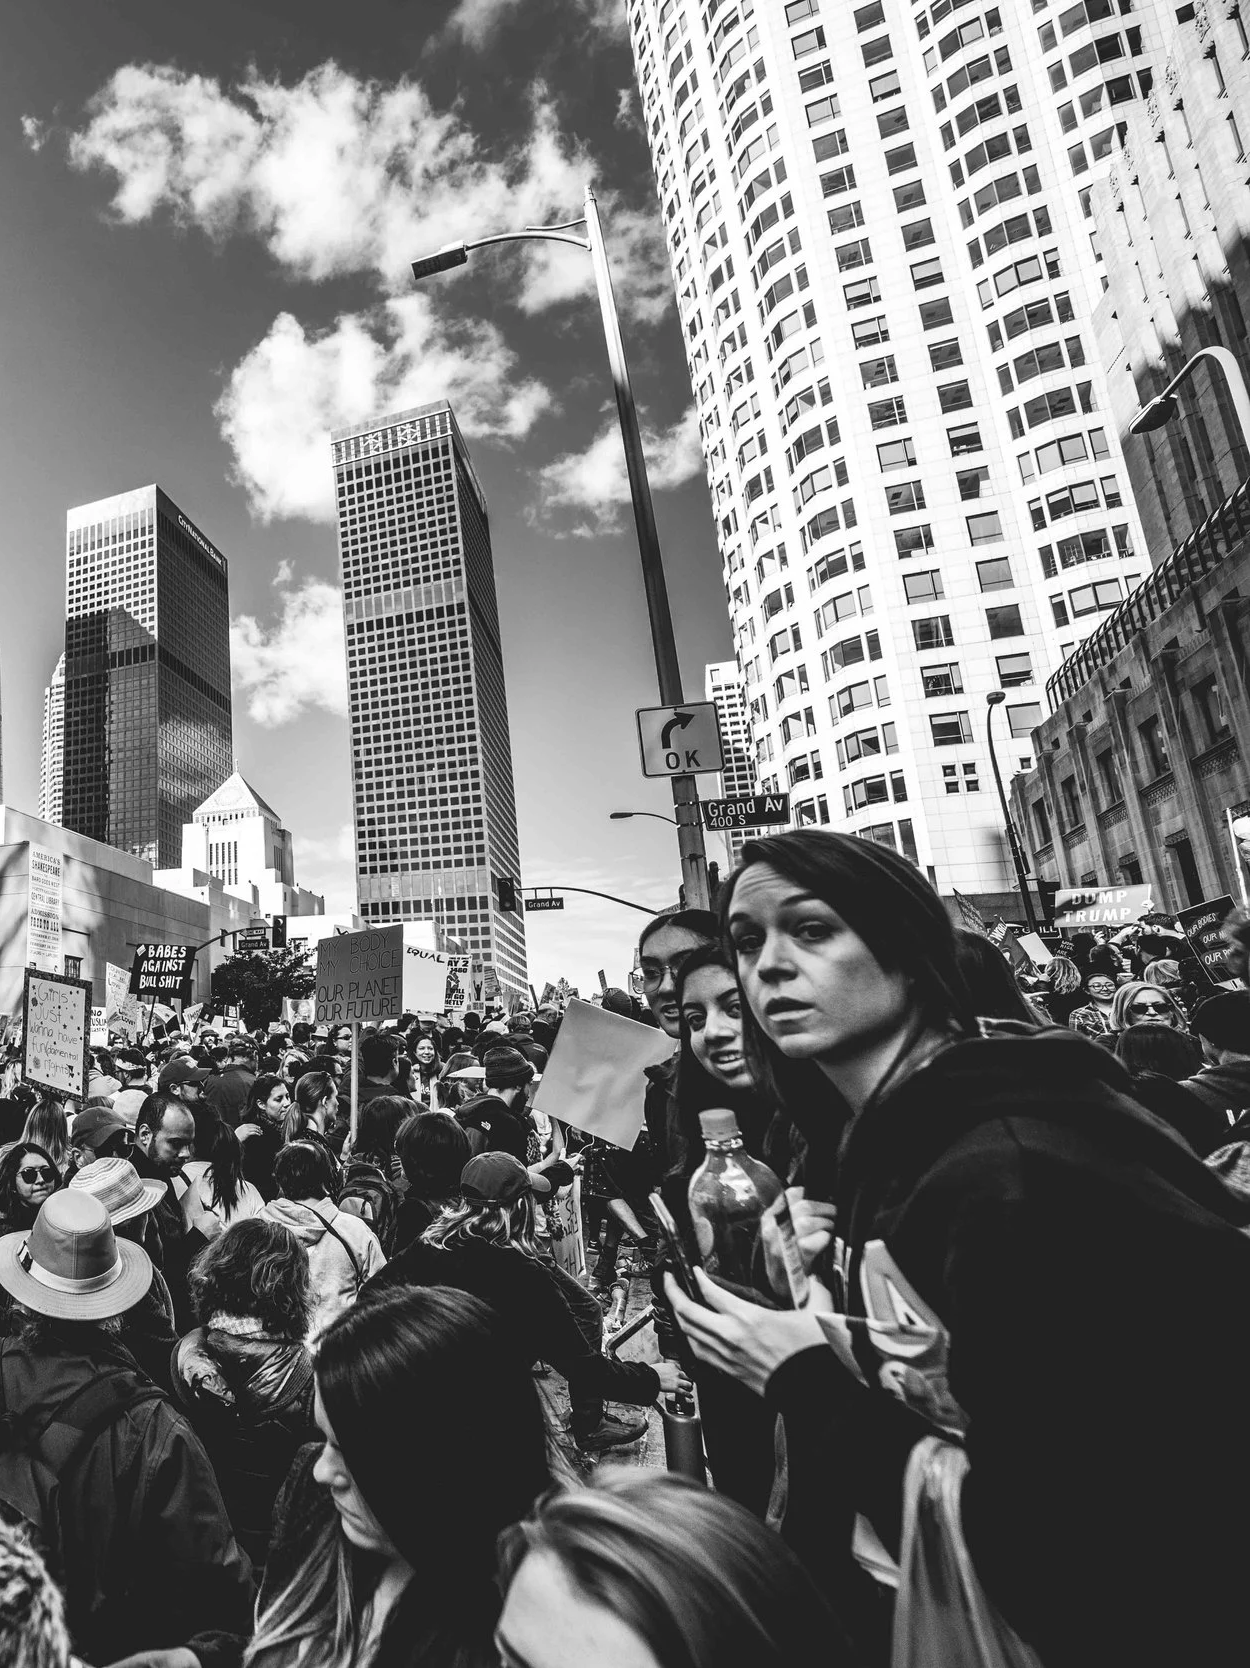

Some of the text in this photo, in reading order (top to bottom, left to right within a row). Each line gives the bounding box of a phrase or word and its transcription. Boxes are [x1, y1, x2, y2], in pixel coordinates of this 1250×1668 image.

[666, 750, 700, 770] OK
[708, 797, 783, 817] Grand Av
[710, 815, 746, 828] 400 S
[32, 851, 60, 866] AMERICA'S
[32, 860, 60, 877] SHAKESPEARE
[1071, 890, 1128, 905] DUMP
[1063, 908, 1132, 922] TRUMP
[1187, 912, 1216, 938] OUR BODIES
[320, 940, 340, 958] MY
[350, 931, 390, 954] BODY
[1202, 932, 1218, 944] OUR
[148, 944, 187, 958] BABES
[407, 946, 445, 964] EQUAL
[1204, 951, 1222, 964] OUR
[140, 959, 186, 972] AGAINST
[320, 948, 402, 976] MY CHOICE
[158, 975, 184, 990] SHIT
[318, 976, 401, 1003] OUR PLANET
[38, 982, 68, 1004] Girls
[316, 996, 400, 1022] OUR FUTURE
[58, 1029, 78, 1044] have
